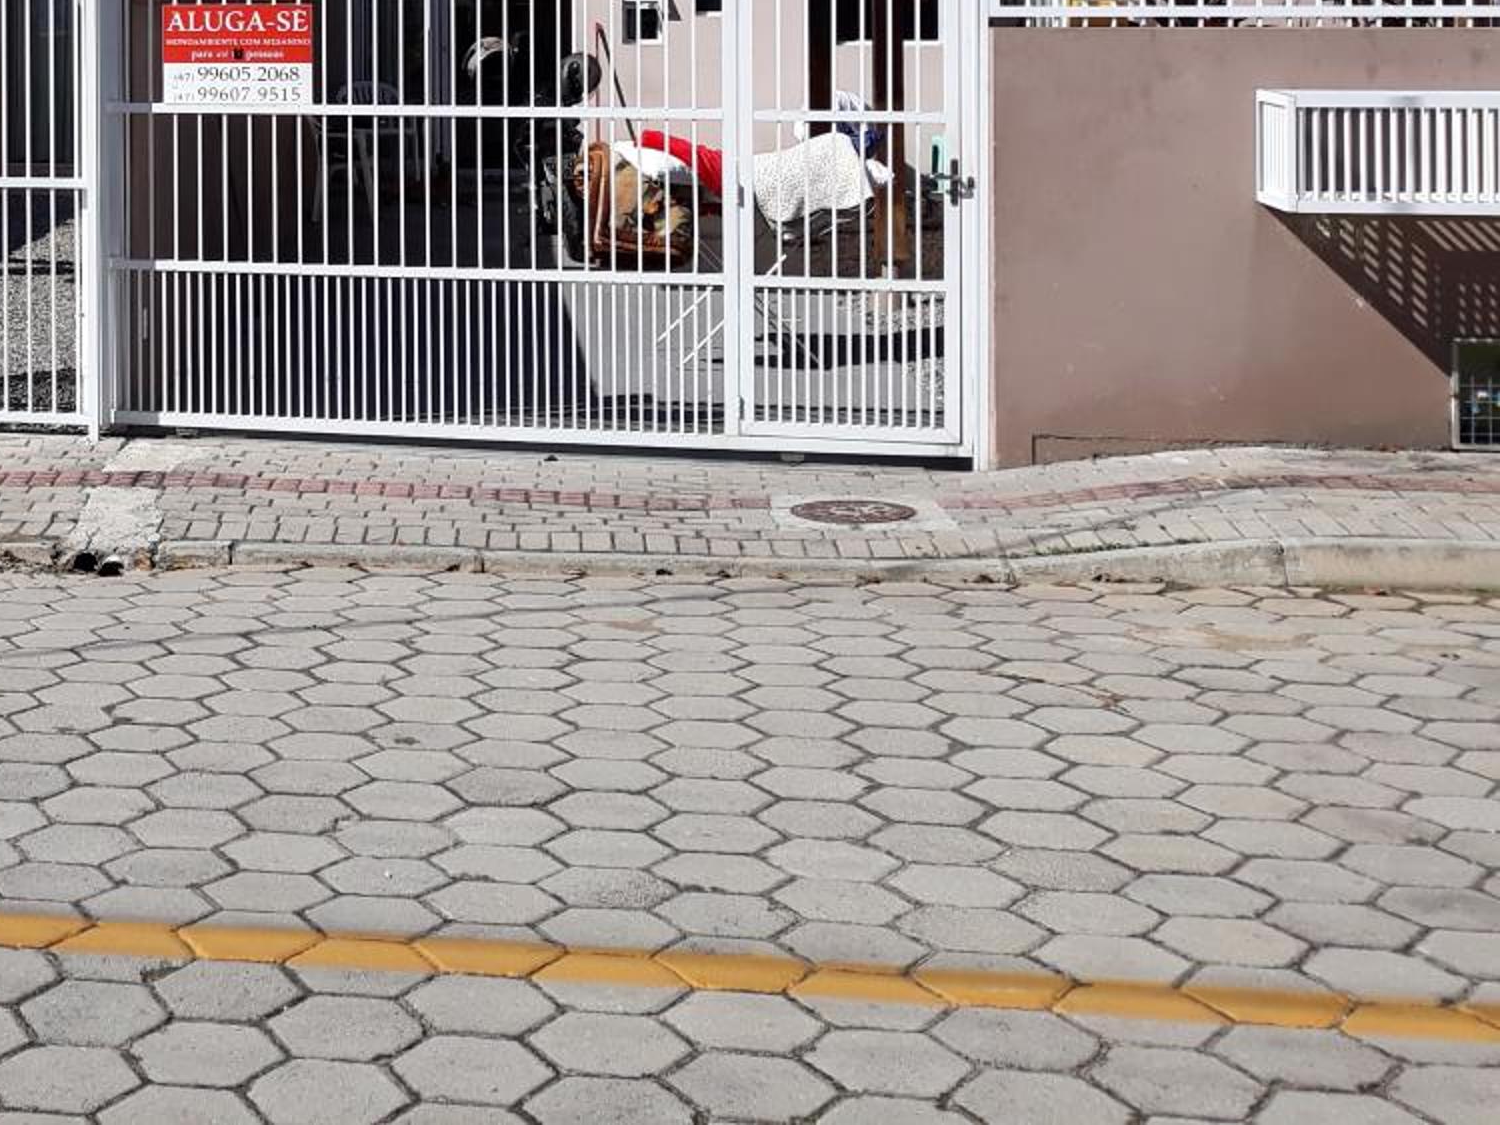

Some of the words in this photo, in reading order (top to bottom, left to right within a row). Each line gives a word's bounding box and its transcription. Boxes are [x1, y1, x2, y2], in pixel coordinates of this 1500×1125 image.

[167, 11, 309, 32] ALUGA-SE
[239, 38, 261, 46] COM
[191, 50, 214, 62] para
